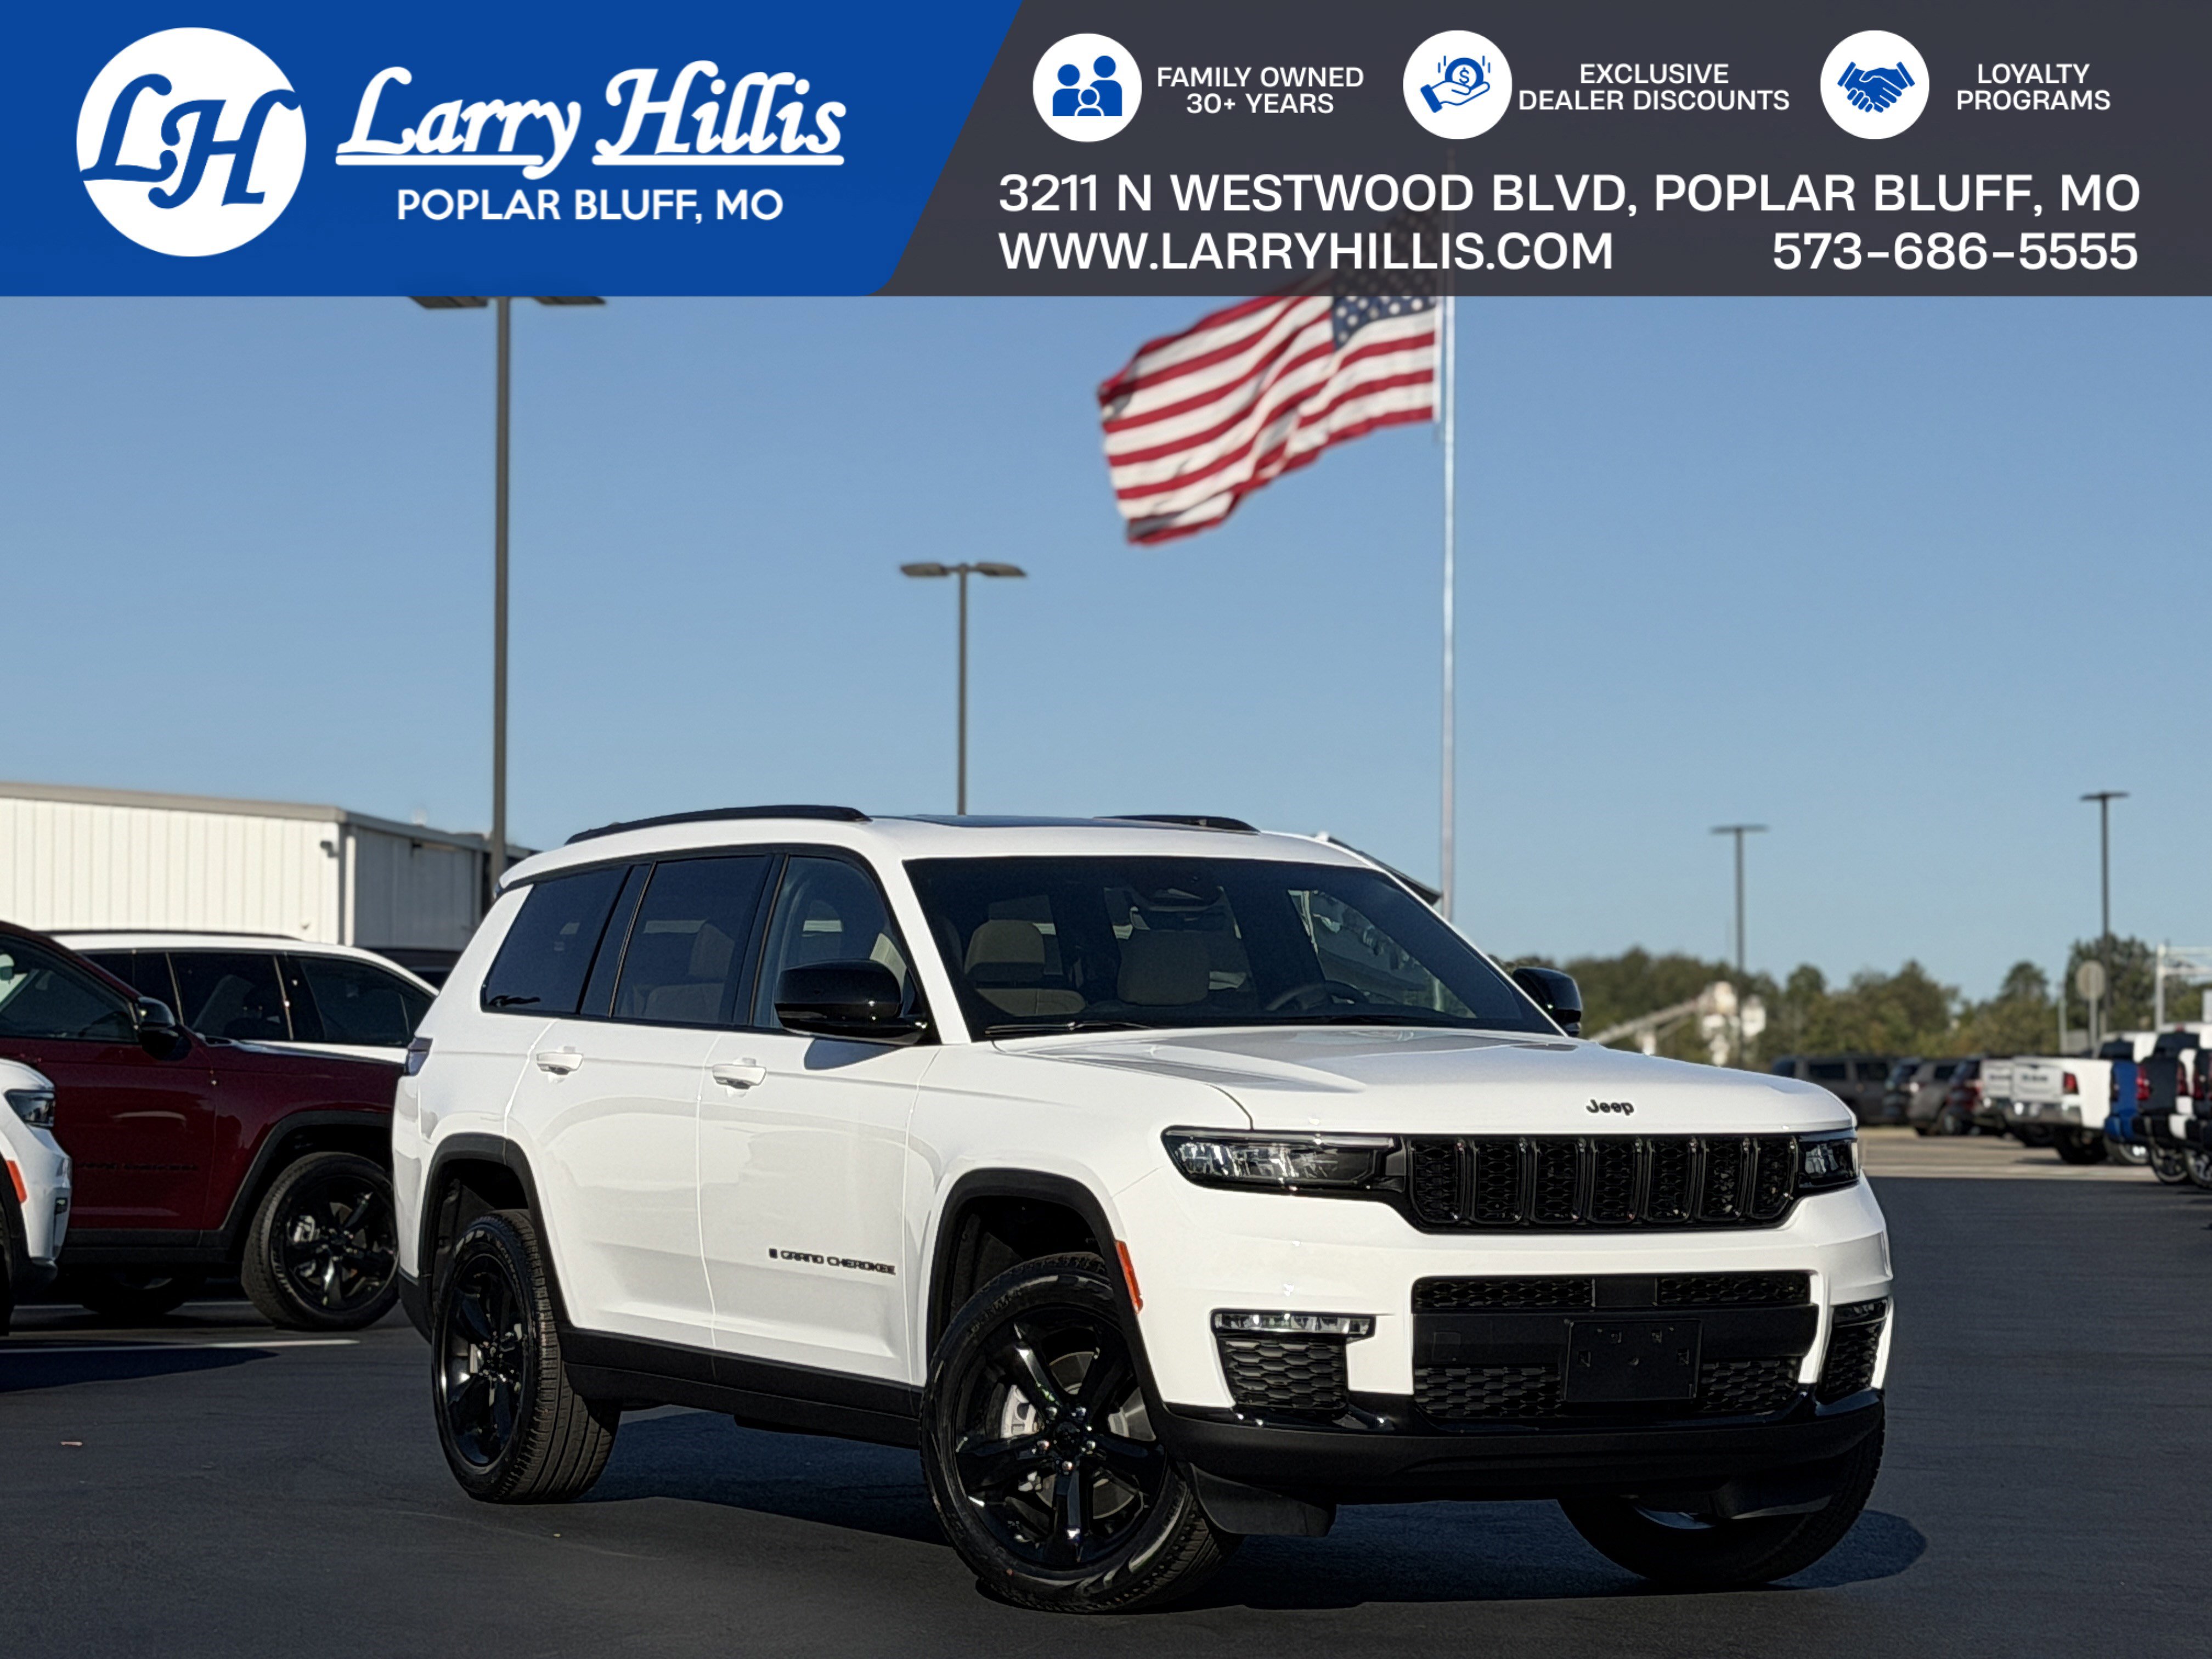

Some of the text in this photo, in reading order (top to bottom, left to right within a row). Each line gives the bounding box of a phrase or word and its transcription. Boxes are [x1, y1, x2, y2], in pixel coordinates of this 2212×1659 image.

[1586, 1099, 1634, 1116] Jeep
[781, 1250, 896, 1276] GRAND CHEROKEE
